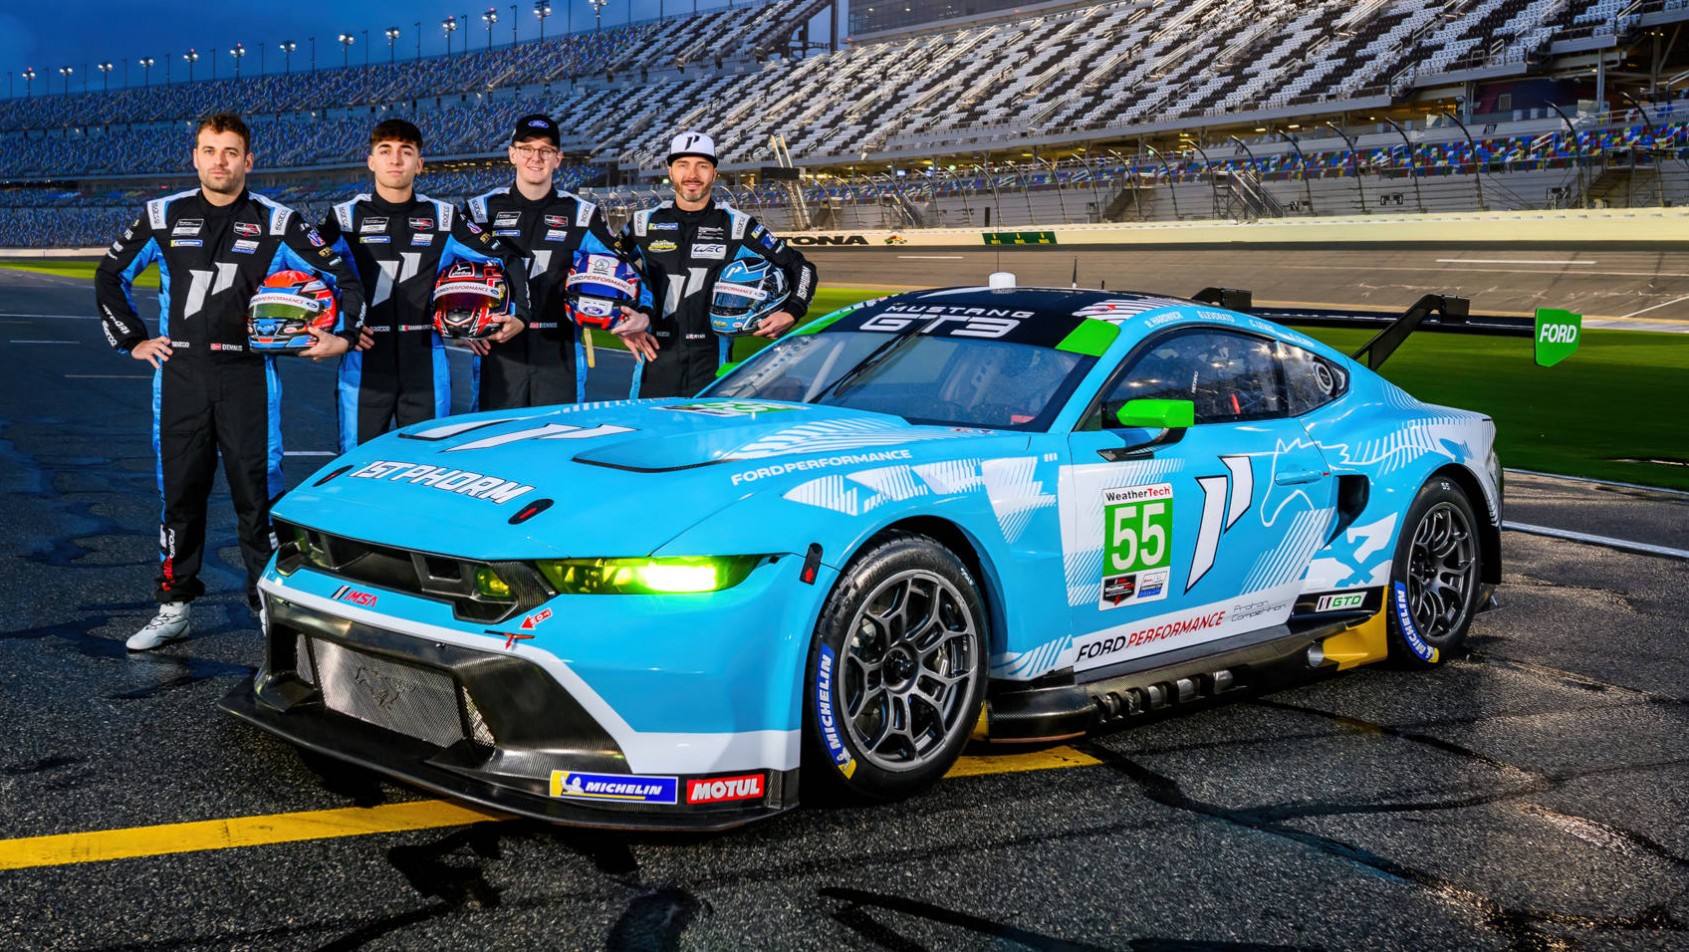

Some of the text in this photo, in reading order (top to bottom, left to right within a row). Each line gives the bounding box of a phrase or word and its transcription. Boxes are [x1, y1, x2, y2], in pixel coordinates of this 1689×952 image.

[694, 245, 724, 253] WEC
[777, 235, 870, 246] TONA
[885, 305, 1035, 319] MUSTANG
[859, 313, 1021, 339] GT3
[1539, 323, 1577, 343] FORD
[1105, 486, 1170, 502] WeatherTech
[1112, 502, 1165, 571] 55
[345, 590, 378, 608] IMSA
[1233, 601, 1269, 613] Proton
[1332, 595, 1362, 608] GTD
[1397, 590, 1429, 656] MICHELIN
[820, 654, 841, 750] MICHELIN
[585, 781, 663, 795] MICHELIN
[691, 778, 760, 800] MOTUL
